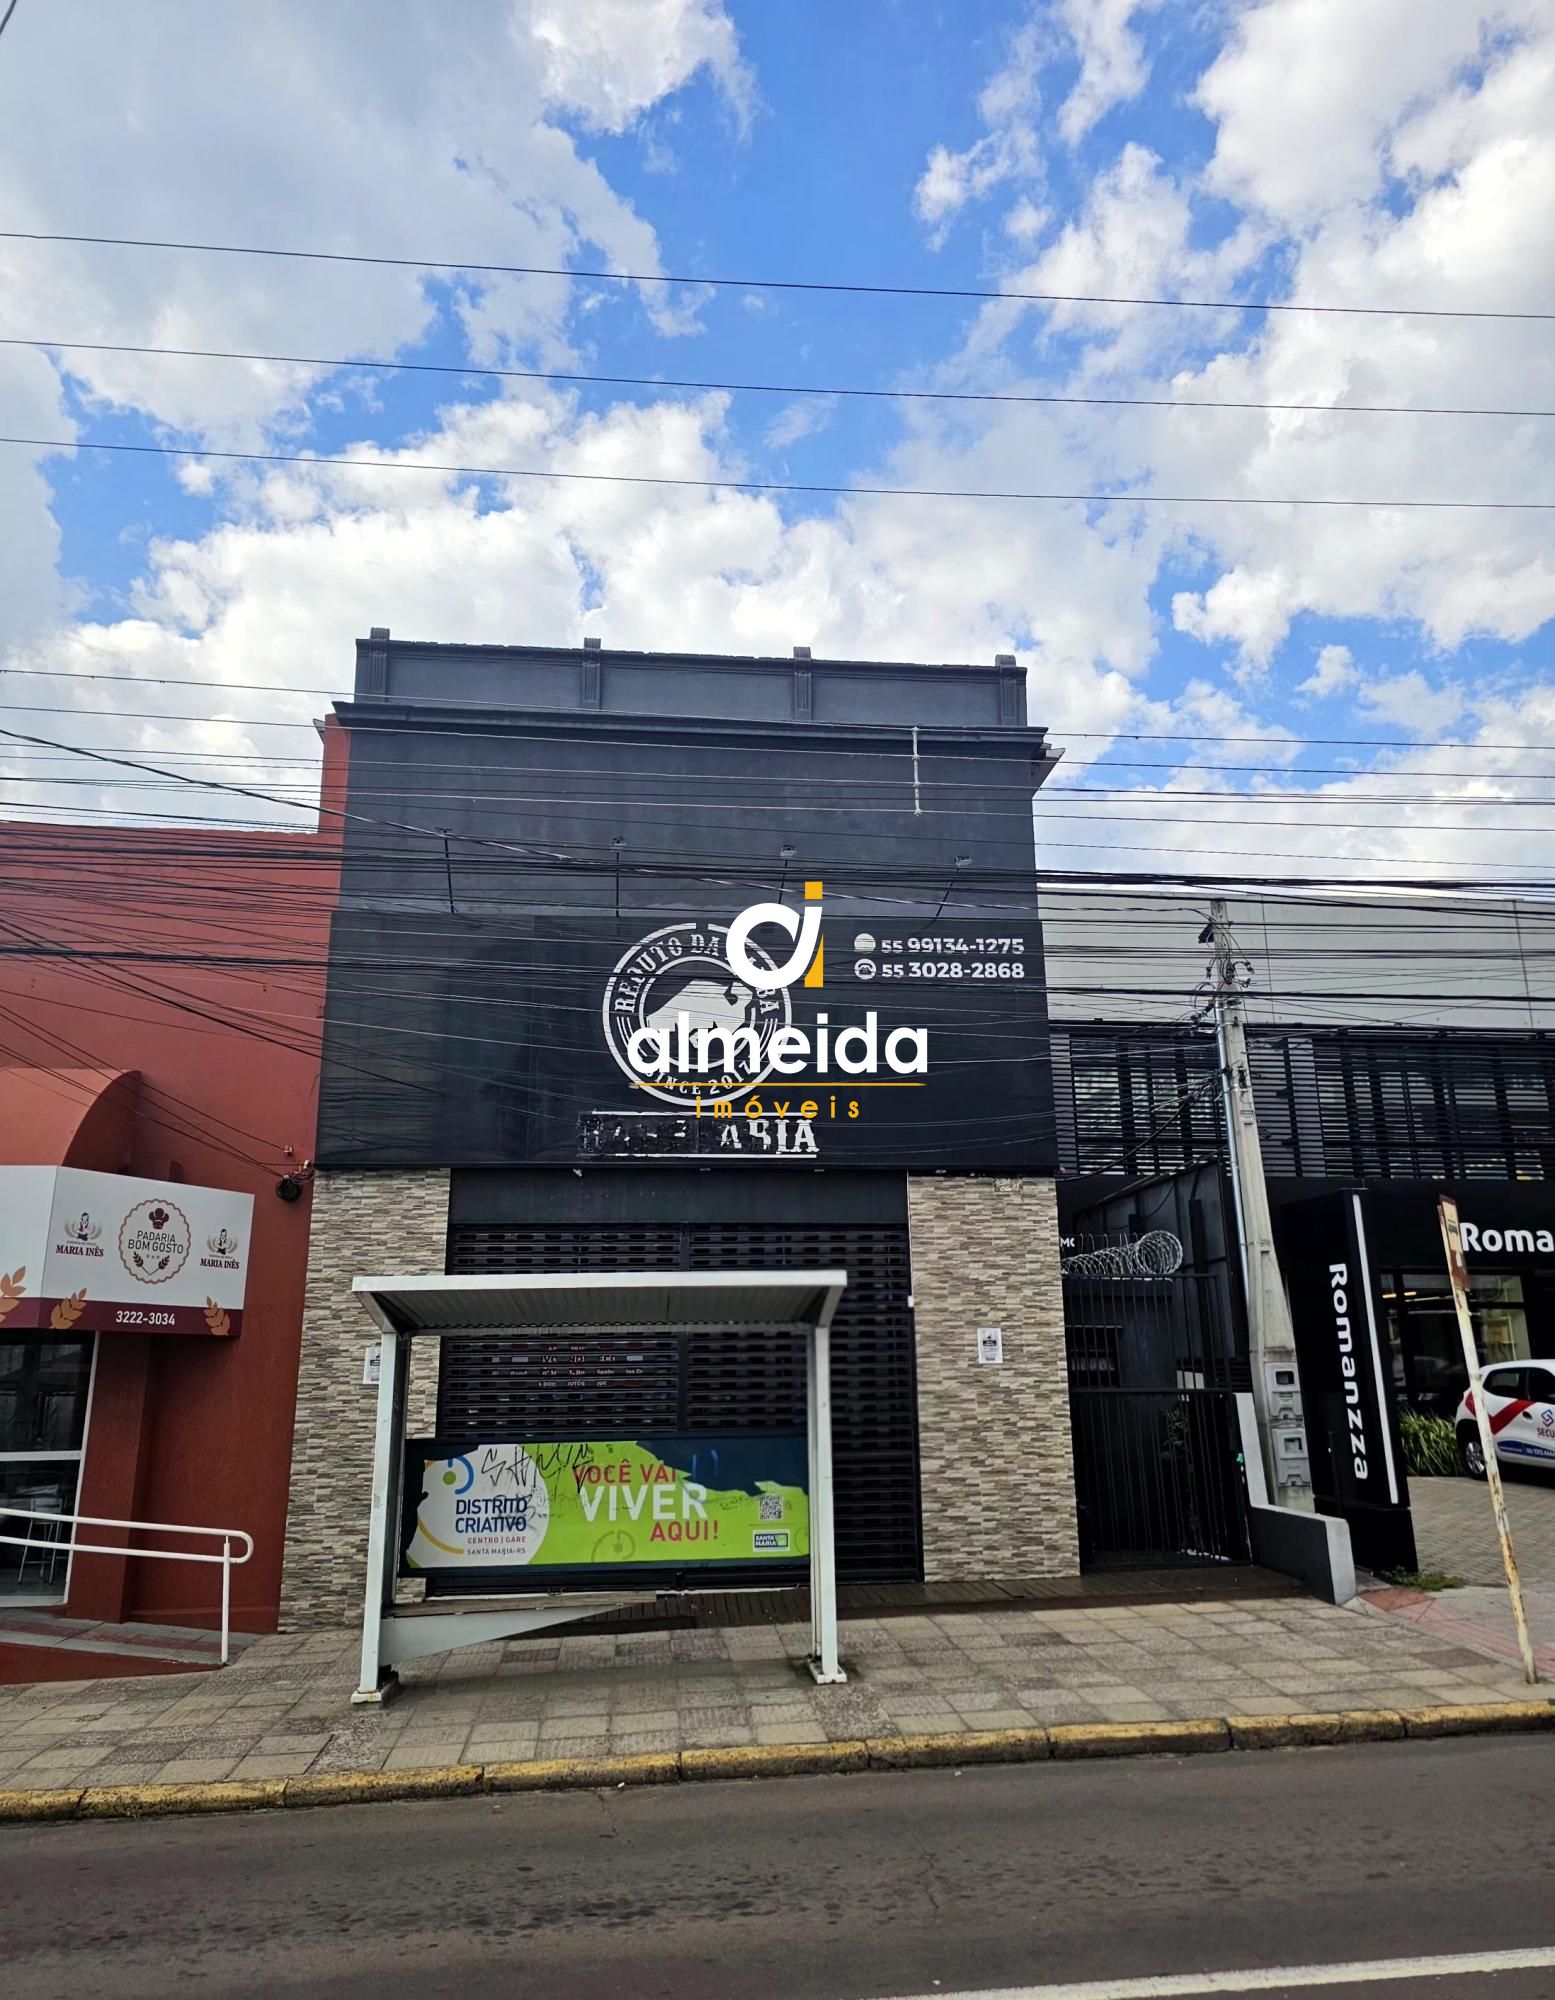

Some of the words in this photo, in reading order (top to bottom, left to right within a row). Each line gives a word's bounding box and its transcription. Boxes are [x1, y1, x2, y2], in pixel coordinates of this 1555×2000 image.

[690, 933, 721, 957] DA
[881, 939, 903, 954] 55
[907, 937, 1025, 955] 99134-1275
[881, 964, 904, 978] 55
[908, 961, 1025, 979] 3028-2868
[137, 1230, 176, 1243] PADARIA
[1459, 1222, 1555, 1253] Roma
[56, 1245, 84, 1256] MARIA
[86, 1246, 104, 1257] INÊS
[128, 1239, 150, 1251] BOM
[152, 1241, 184, 1254] GOSTO
[200, 1257, 223, 1268] MARIA
[224, 1259, 240, 1270] INÊS
[115, 1310, 176, 1326] 3222-3034
[1329, 1263, 1369, 1480] Romanzza
[572, 1458, 632, 1485] VOCÊ
[455, 1498, 528, 1515] DISTRITO
[579, 1483, 709, 1523] VIVER
[455, 1516, 527, 1533] CRIATIVO
[650, 1519, 719, 1542] AQUI!
[467, 1536, 499, 1545] CENTRO
